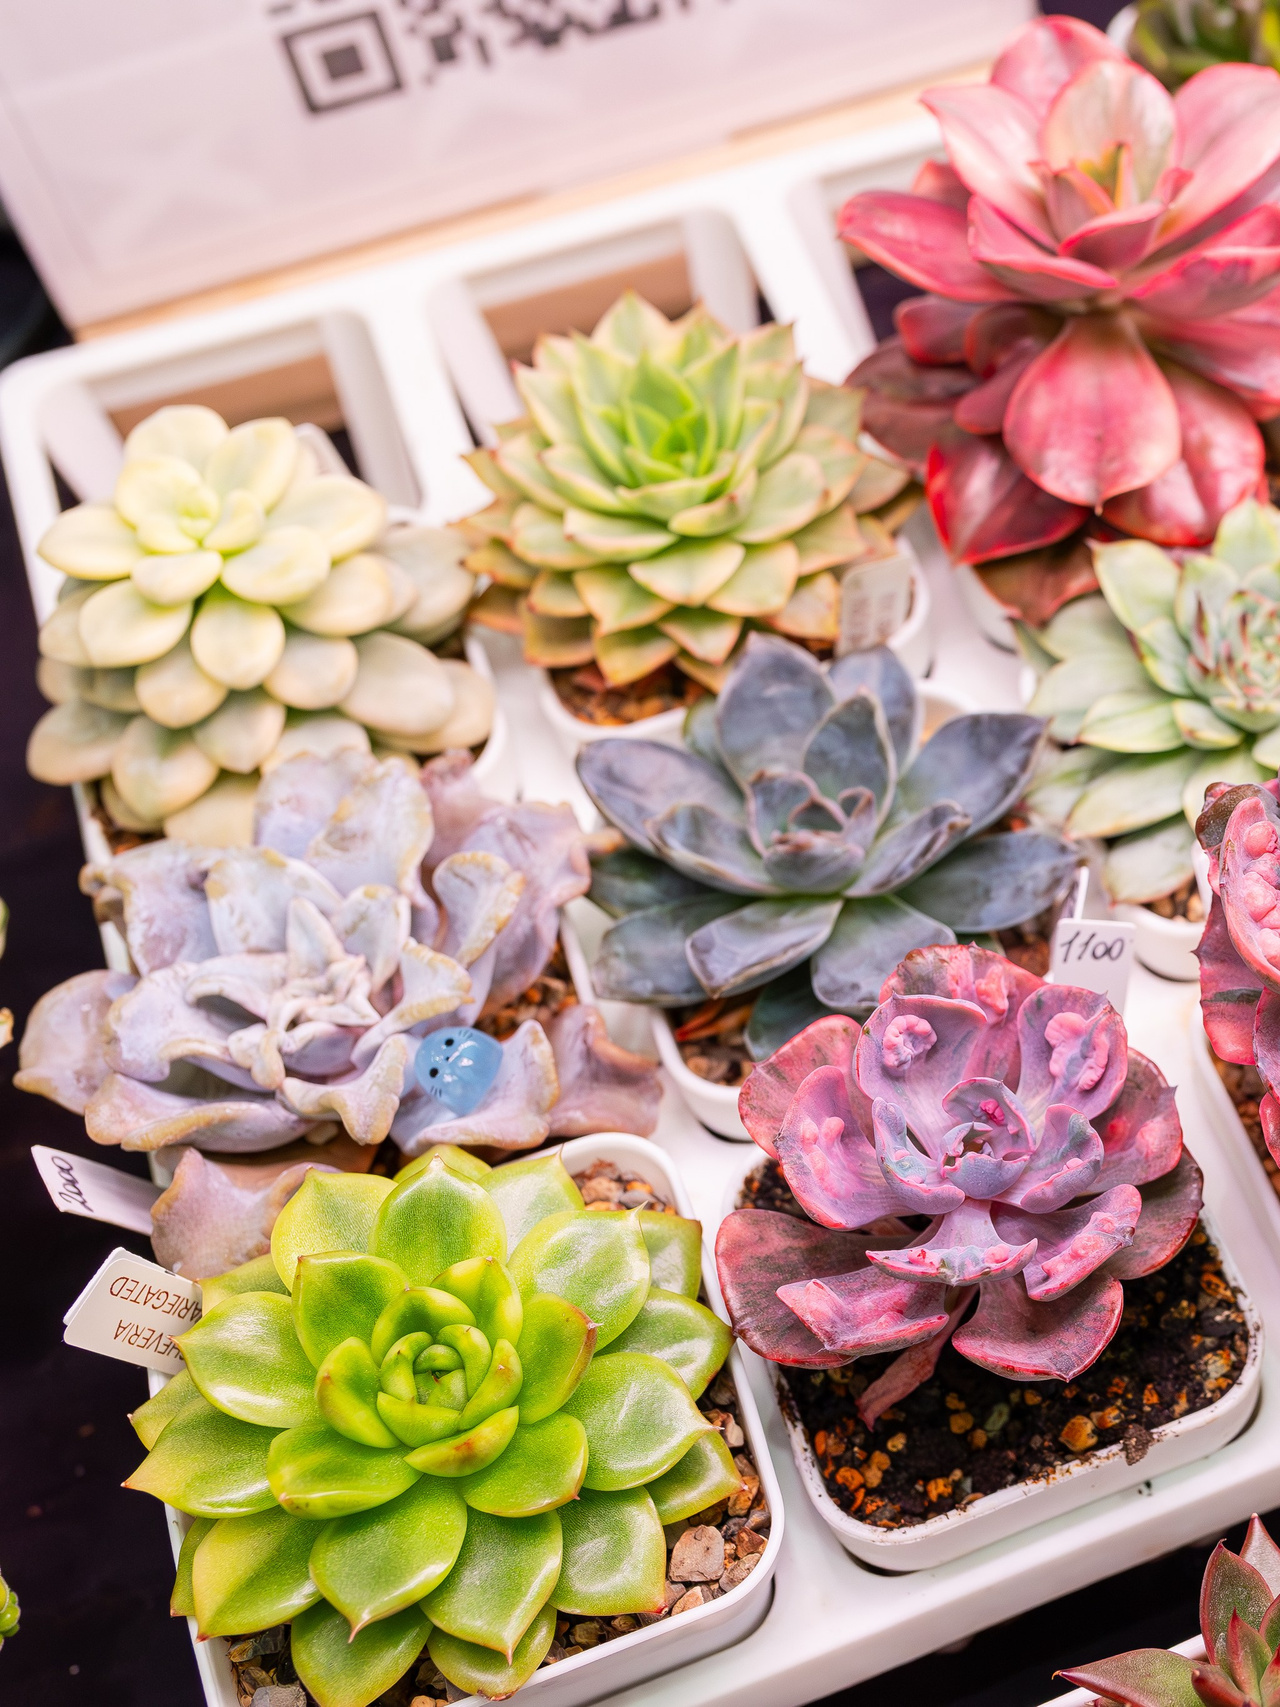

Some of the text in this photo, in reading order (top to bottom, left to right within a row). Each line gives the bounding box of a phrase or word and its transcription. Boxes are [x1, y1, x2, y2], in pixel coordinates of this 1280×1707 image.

[1060, 930, 1125, 963] 1100
[51, 1155, 94, 1213] 2000
[113, 1319, 185, 1361] HEVERIA
